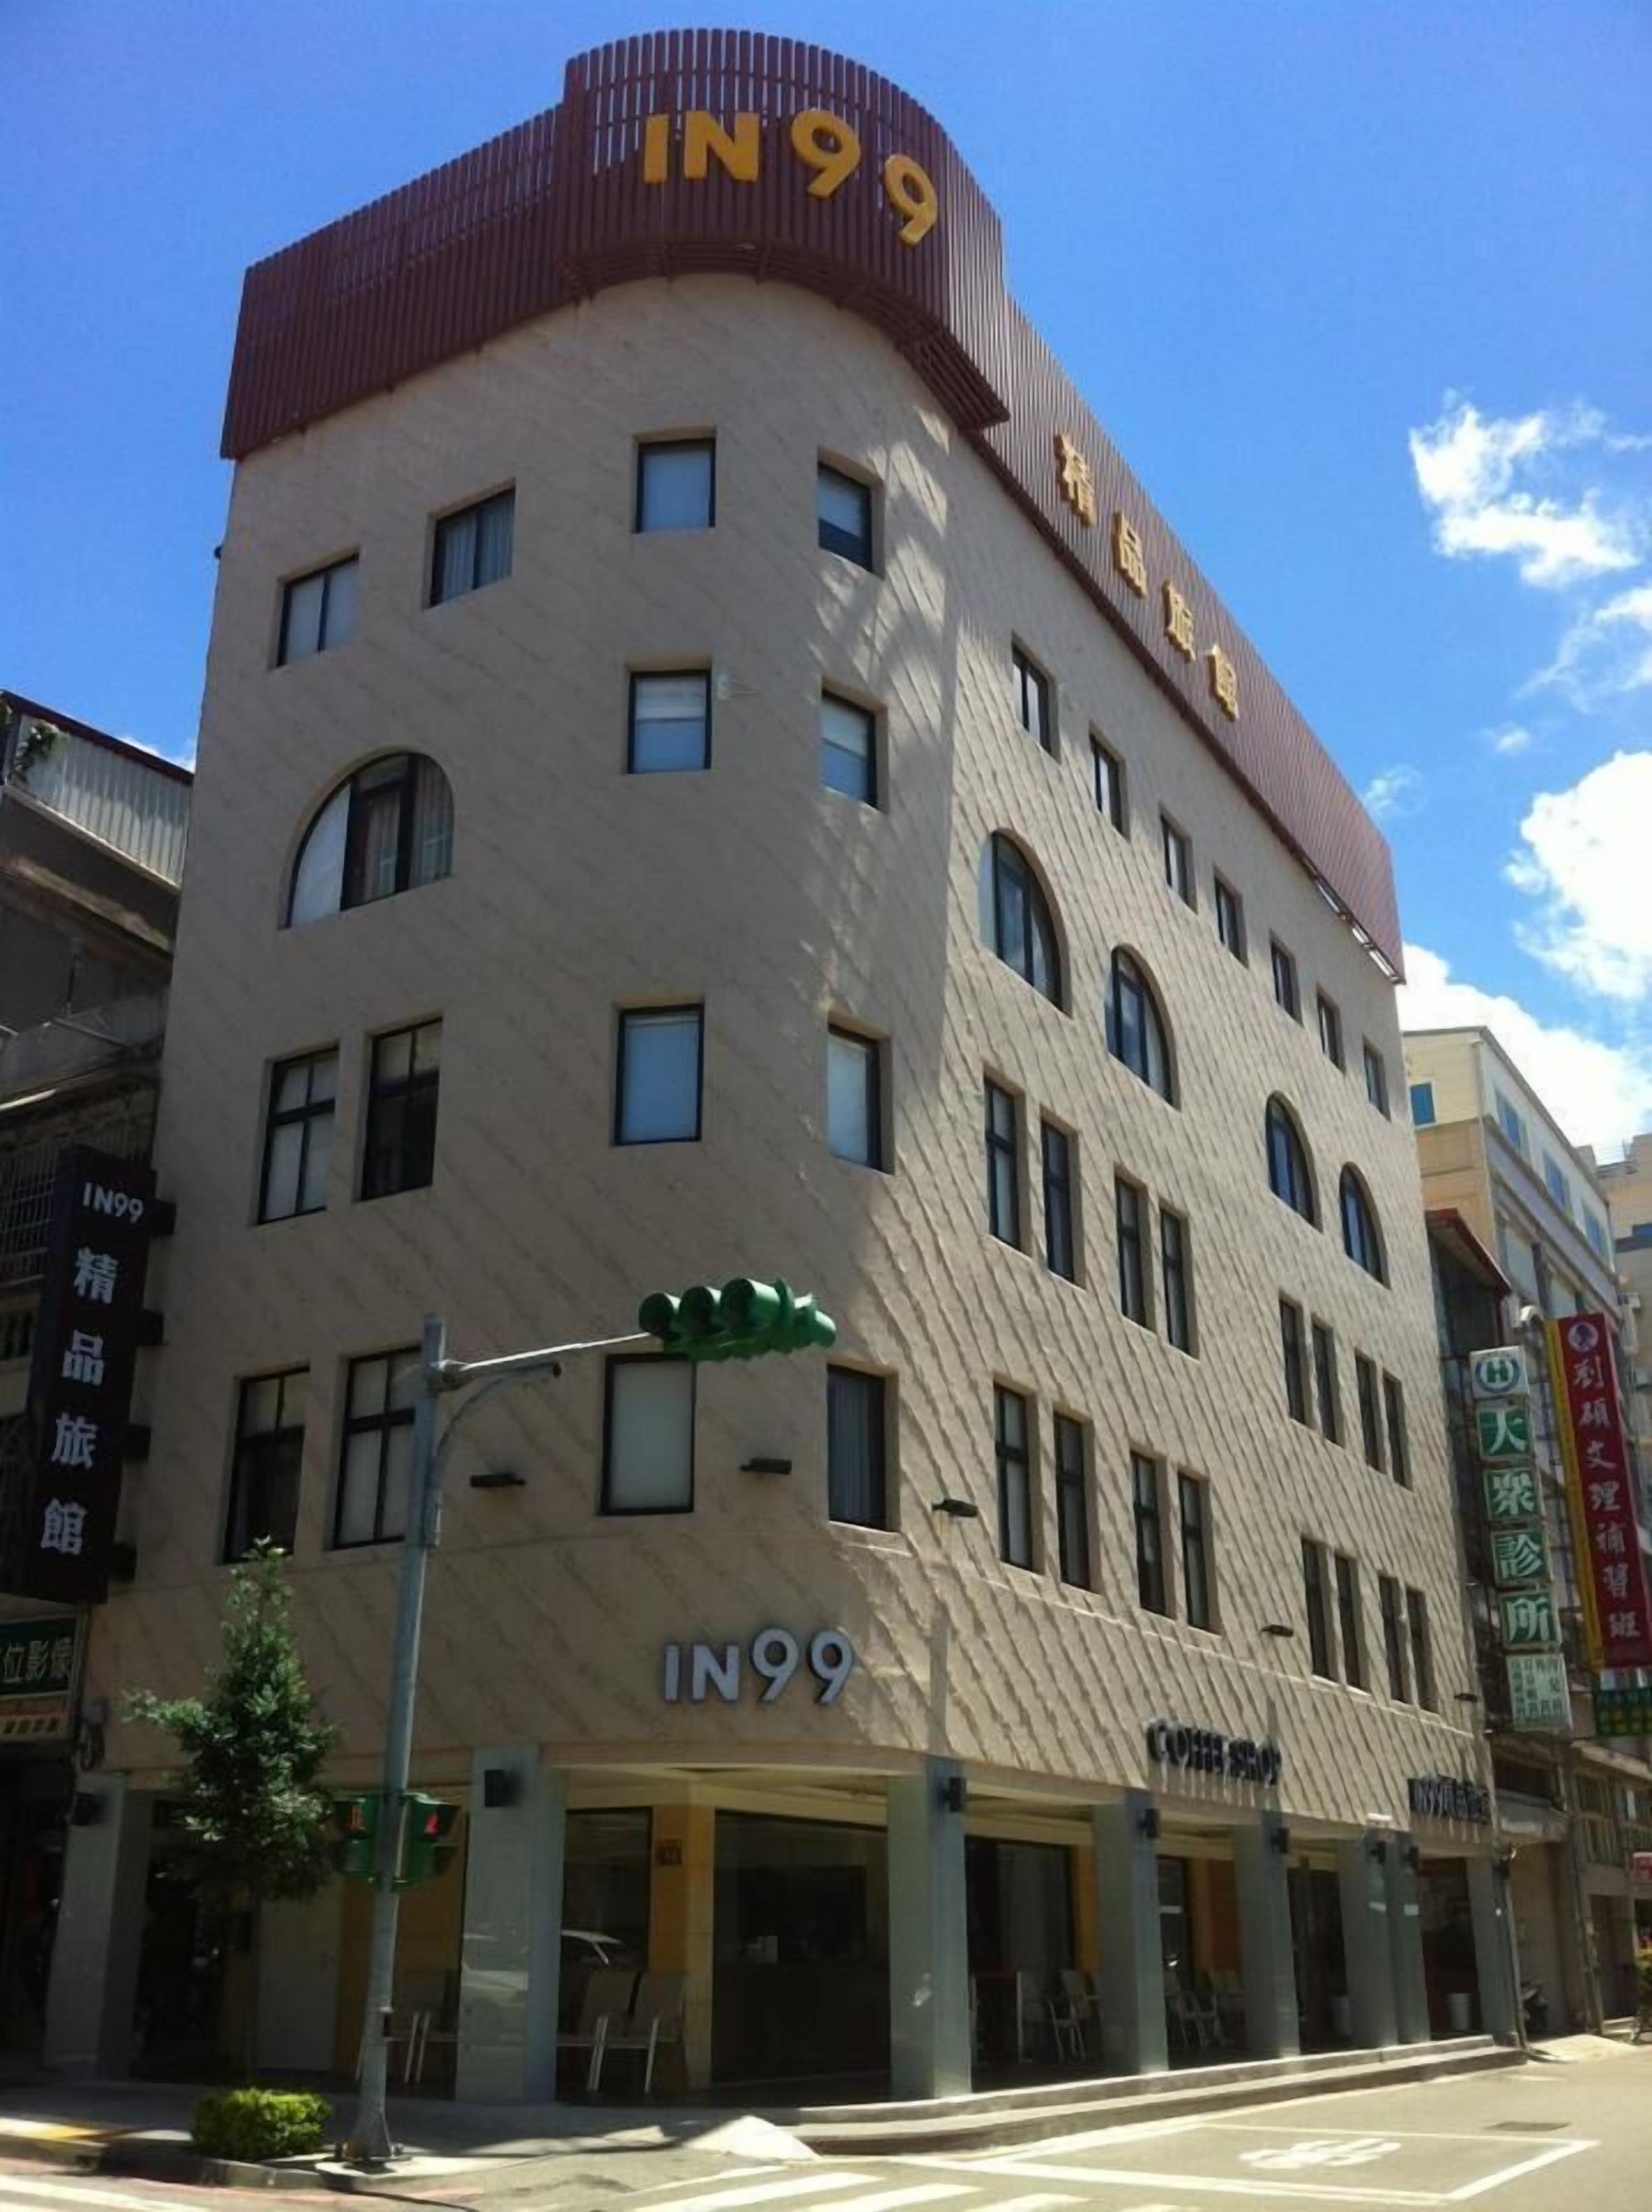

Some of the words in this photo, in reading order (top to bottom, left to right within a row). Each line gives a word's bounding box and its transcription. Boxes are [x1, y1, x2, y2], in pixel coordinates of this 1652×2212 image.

[643, 109, 938, 246] IN99
[81, 1182, 144, 1224] IN99
[40, 1247, 118, 1555] 精品旅館
[664, 1628, 854, 1705] IN99
